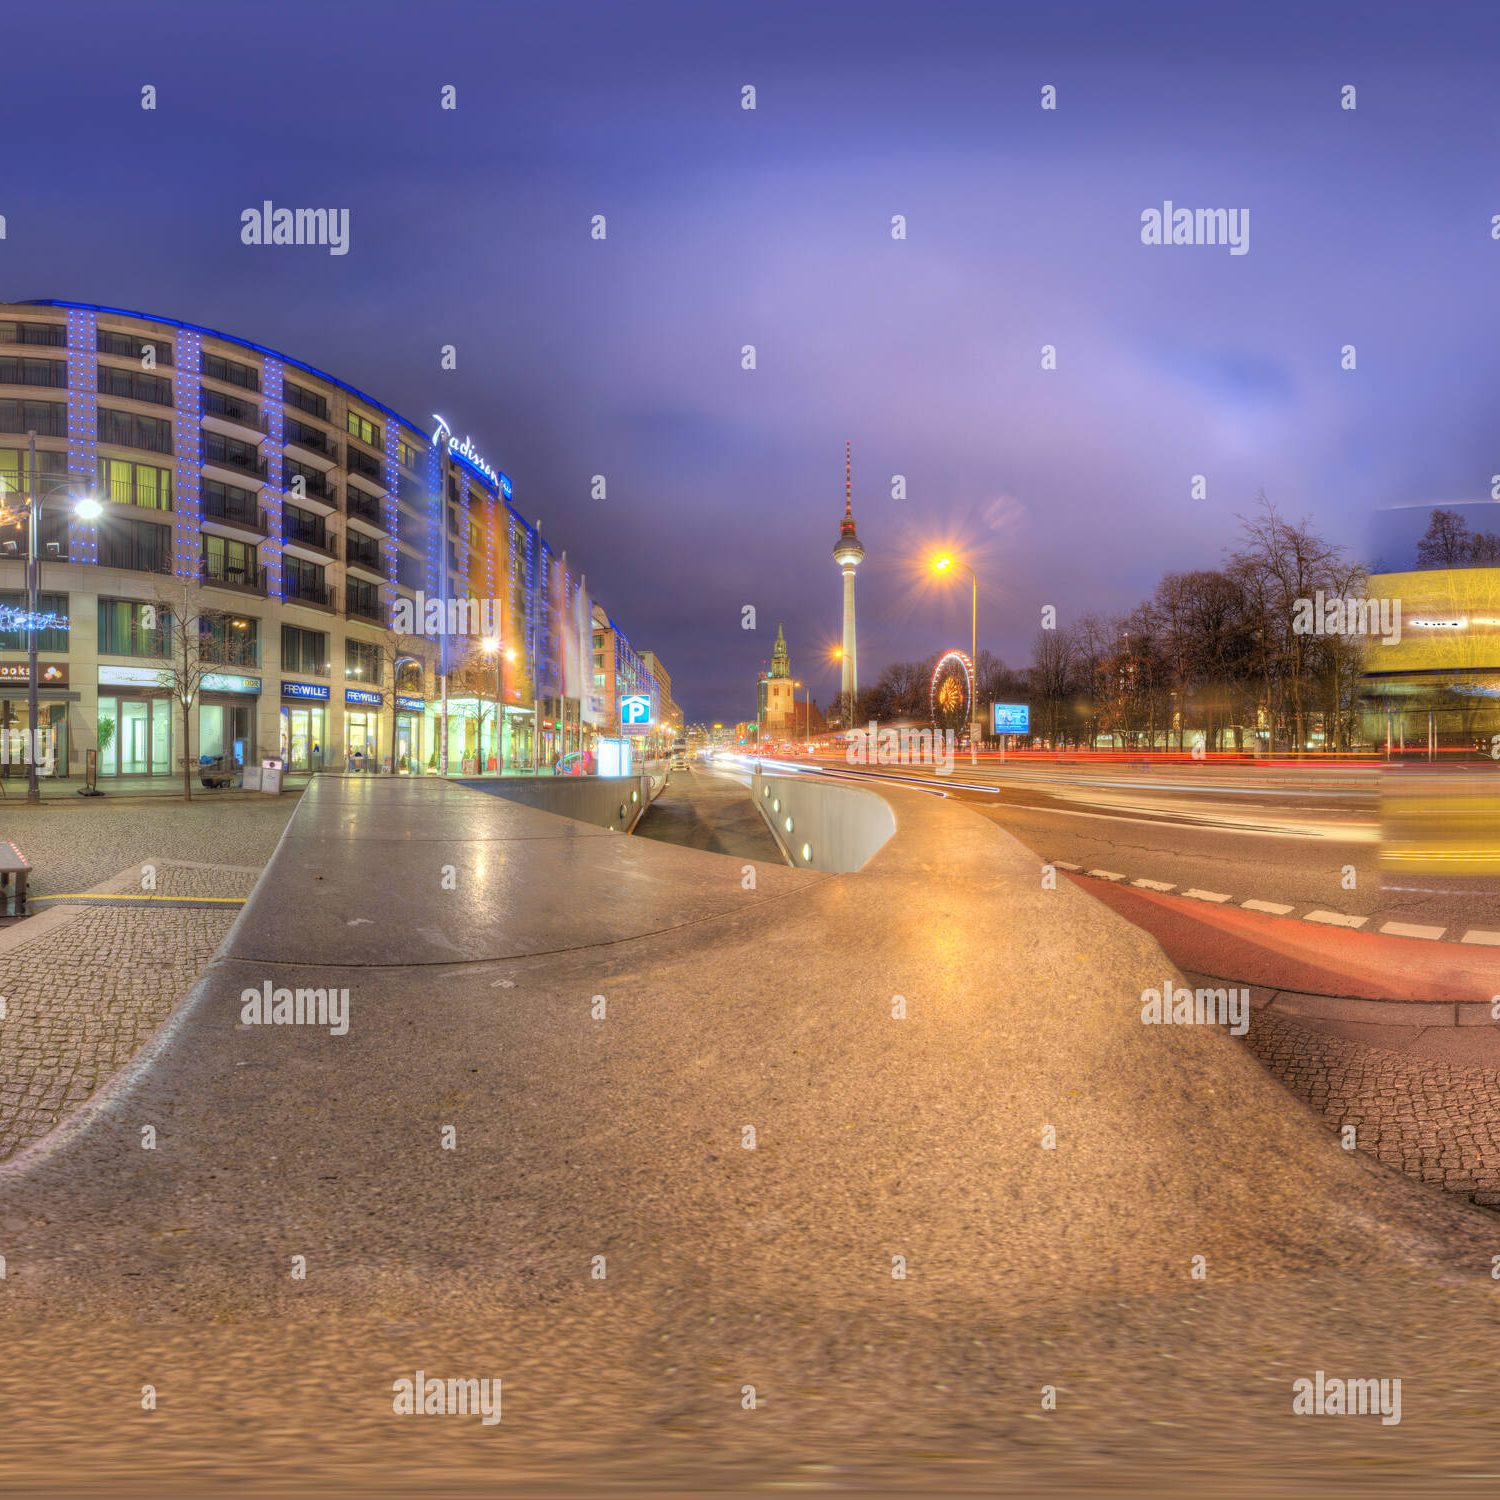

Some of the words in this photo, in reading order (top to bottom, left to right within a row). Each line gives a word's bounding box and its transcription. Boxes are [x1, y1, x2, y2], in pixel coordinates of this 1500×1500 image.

[283, 684, 327, 697] FREYWILLE
[348, 691, 381, 703] FREYWILLE
[629, 702, 645, 723] P
